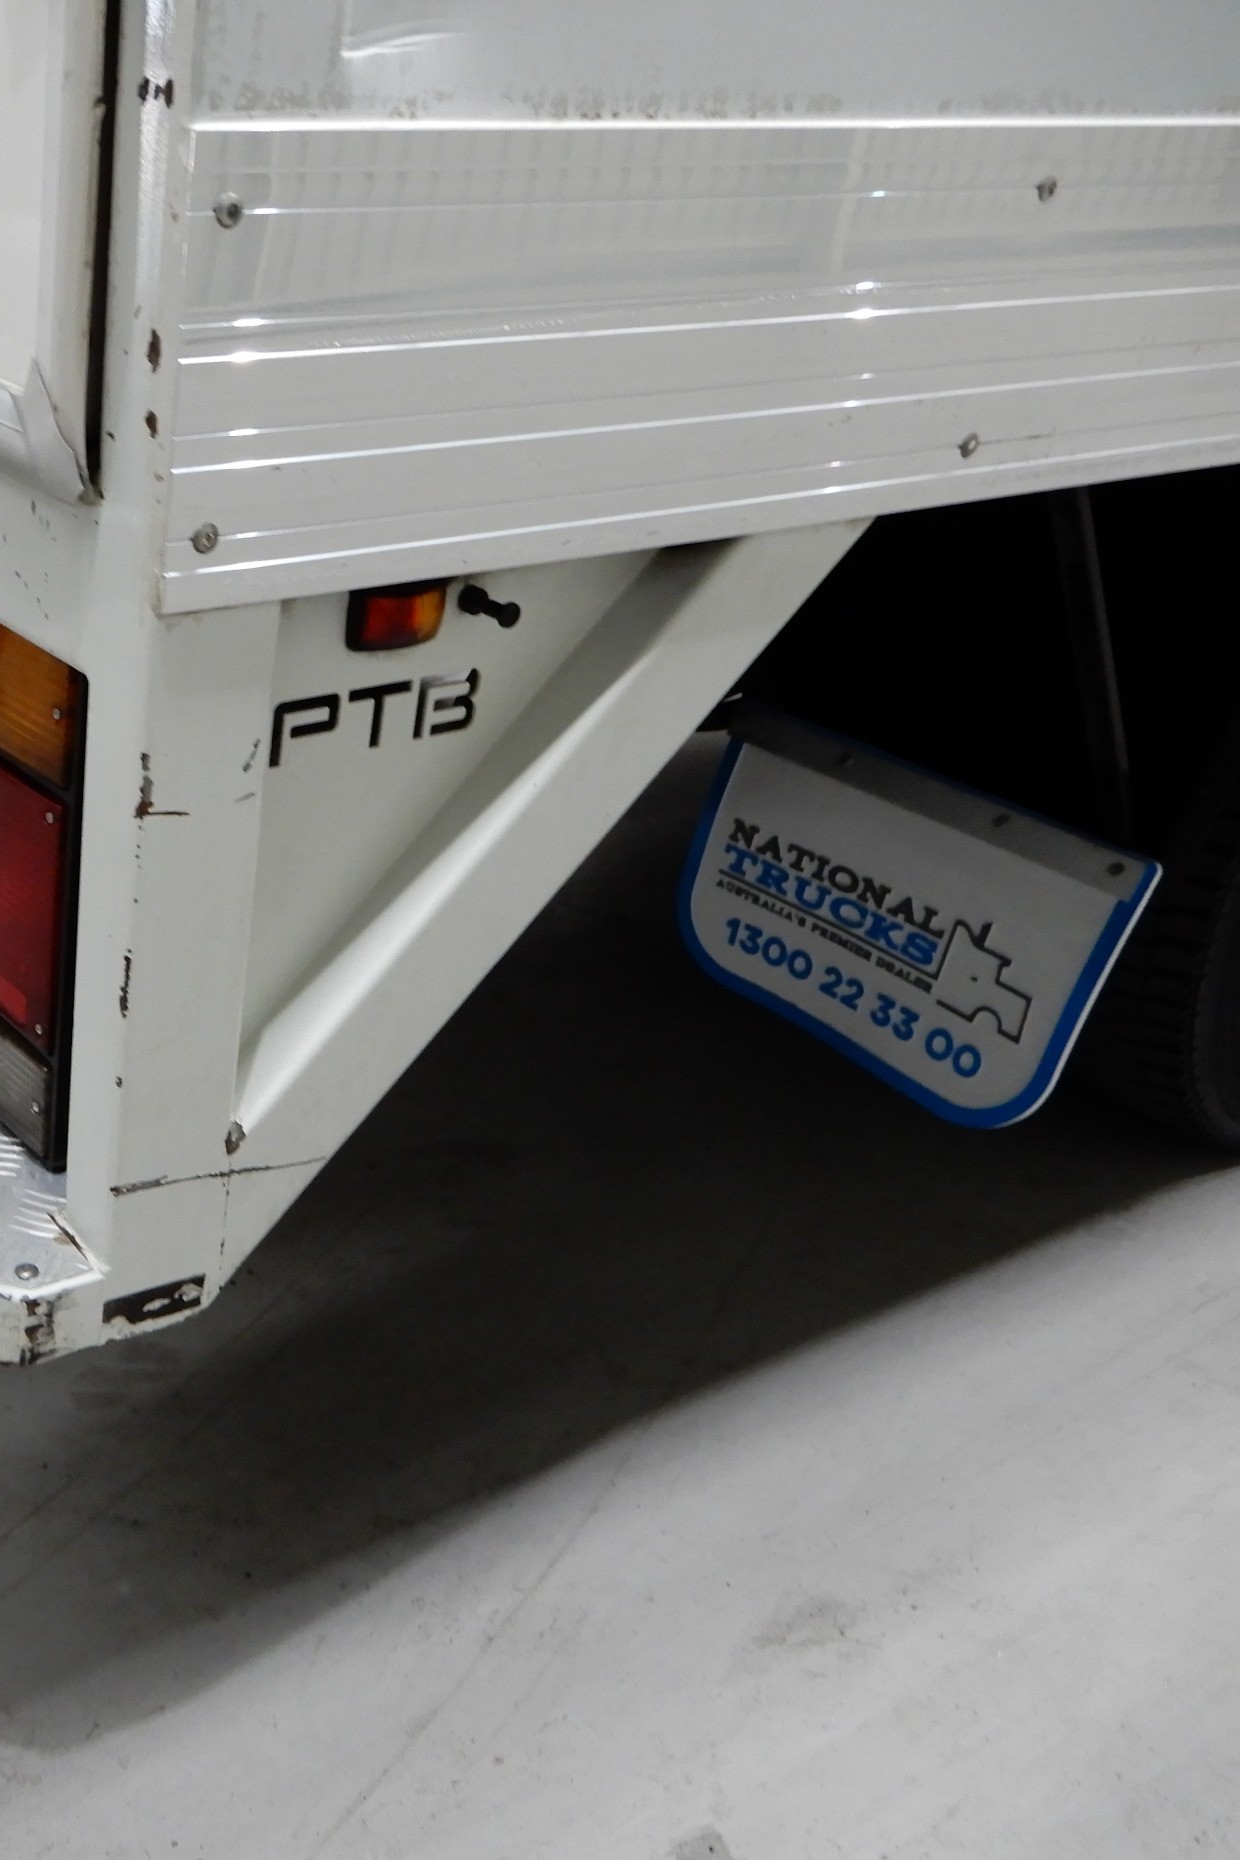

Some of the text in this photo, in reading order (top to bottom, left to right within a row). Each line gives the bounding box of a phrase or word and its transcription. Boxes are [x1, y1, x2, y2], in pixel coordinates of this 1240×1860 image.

[268, 667, 480, 768] PTB
[724, 843, 938, 966] TRUCKS
[728, 818, 945, 939] NATIONAL
[726, 918, 982, 1078] 1300 22 33 00
